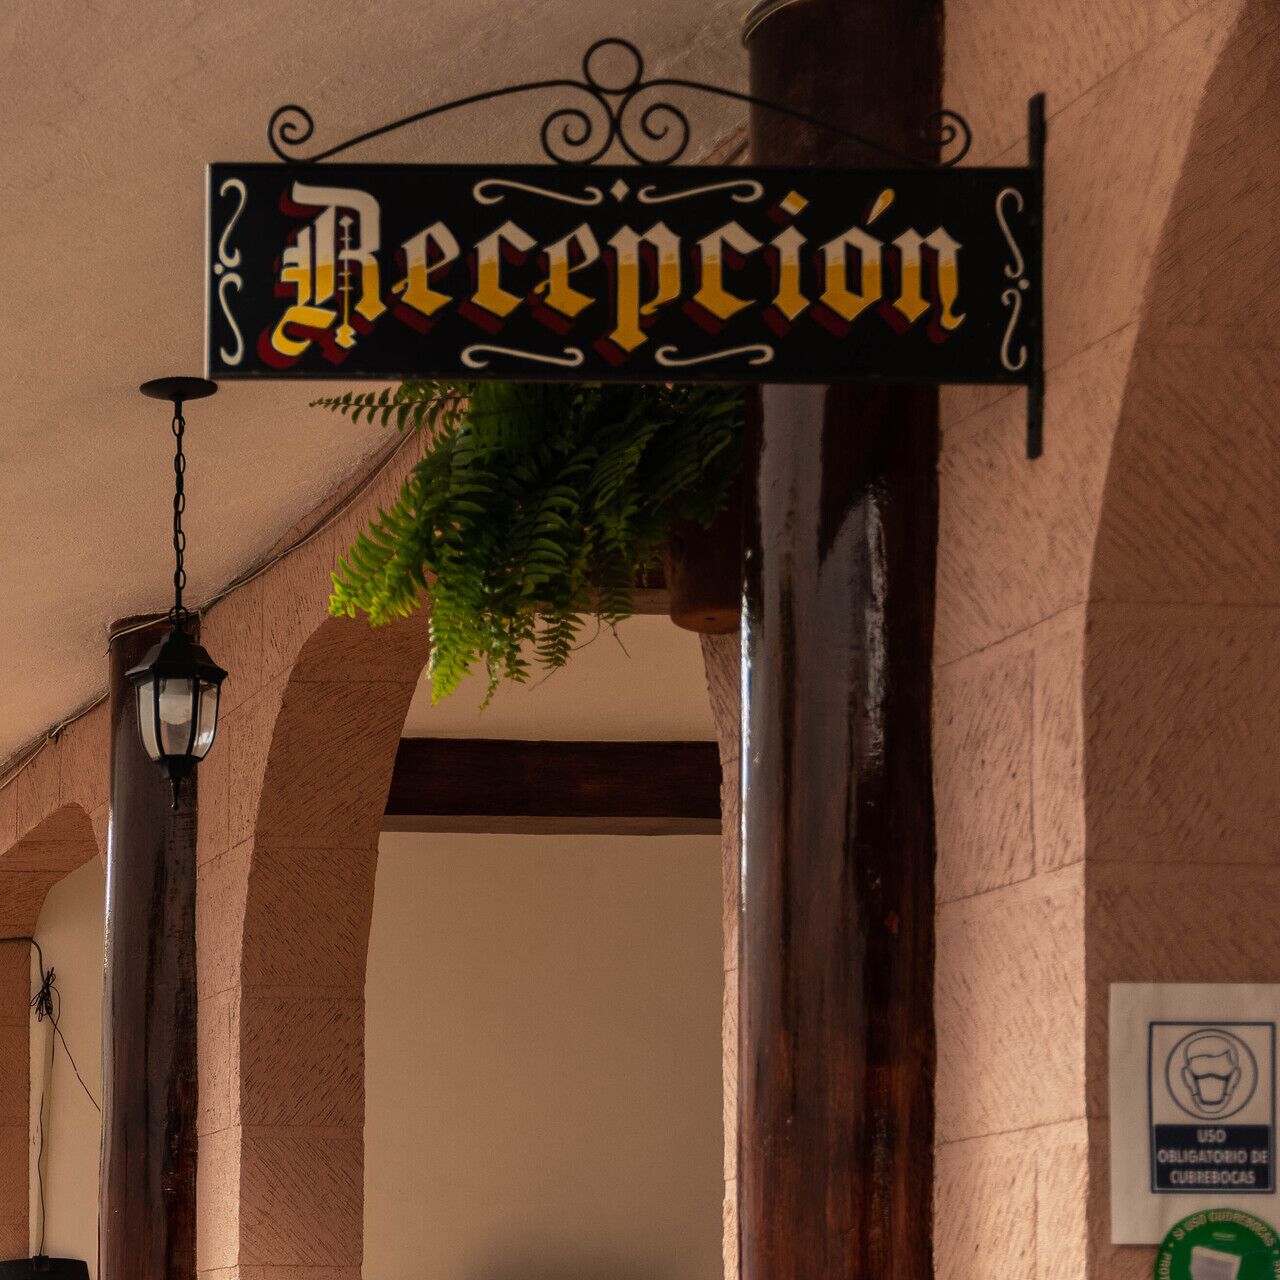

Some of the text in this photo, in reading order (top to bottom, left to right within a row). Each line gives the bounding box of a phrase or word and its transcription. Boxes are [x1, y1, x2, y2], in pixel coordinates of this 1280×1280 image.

[266, 181, 966, 358] Recepción
[1196, 1129, 1227, 1143] USO
[1157, 1149, 1269, 1163] OBLIGATORIO DE
[1169, 1169, 1256, 1184] CUBREBOCAS
